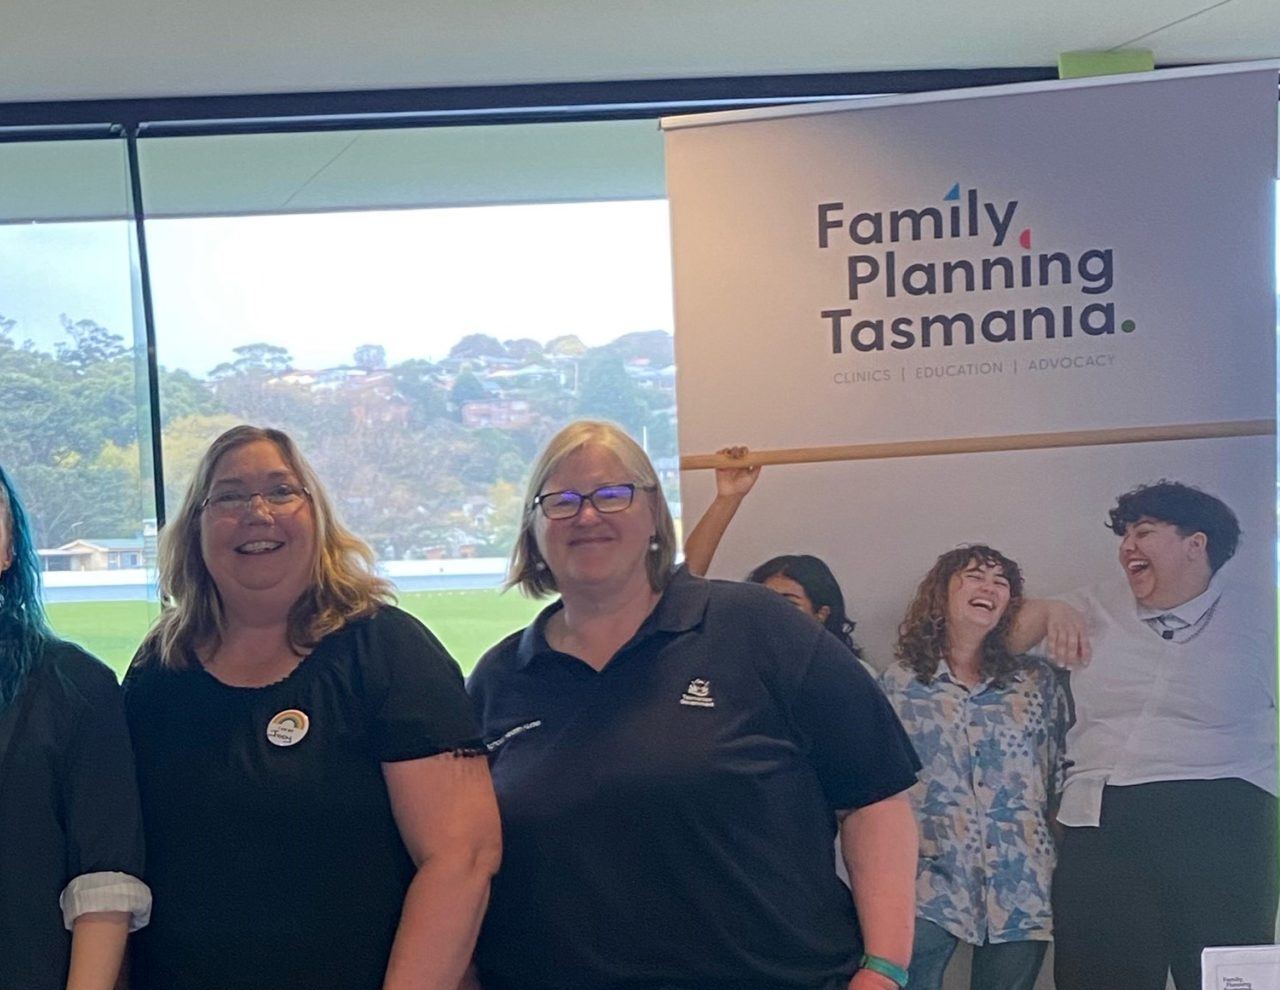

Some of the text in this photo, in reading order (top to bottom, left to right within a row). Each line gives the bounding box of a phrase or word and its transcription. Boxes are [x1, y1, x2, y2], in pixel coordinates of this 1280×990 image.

[848, 230, 1114, 301] Planning
[833, 354, 1116, 385] CLINICS EDUCATION ADVOCACY
